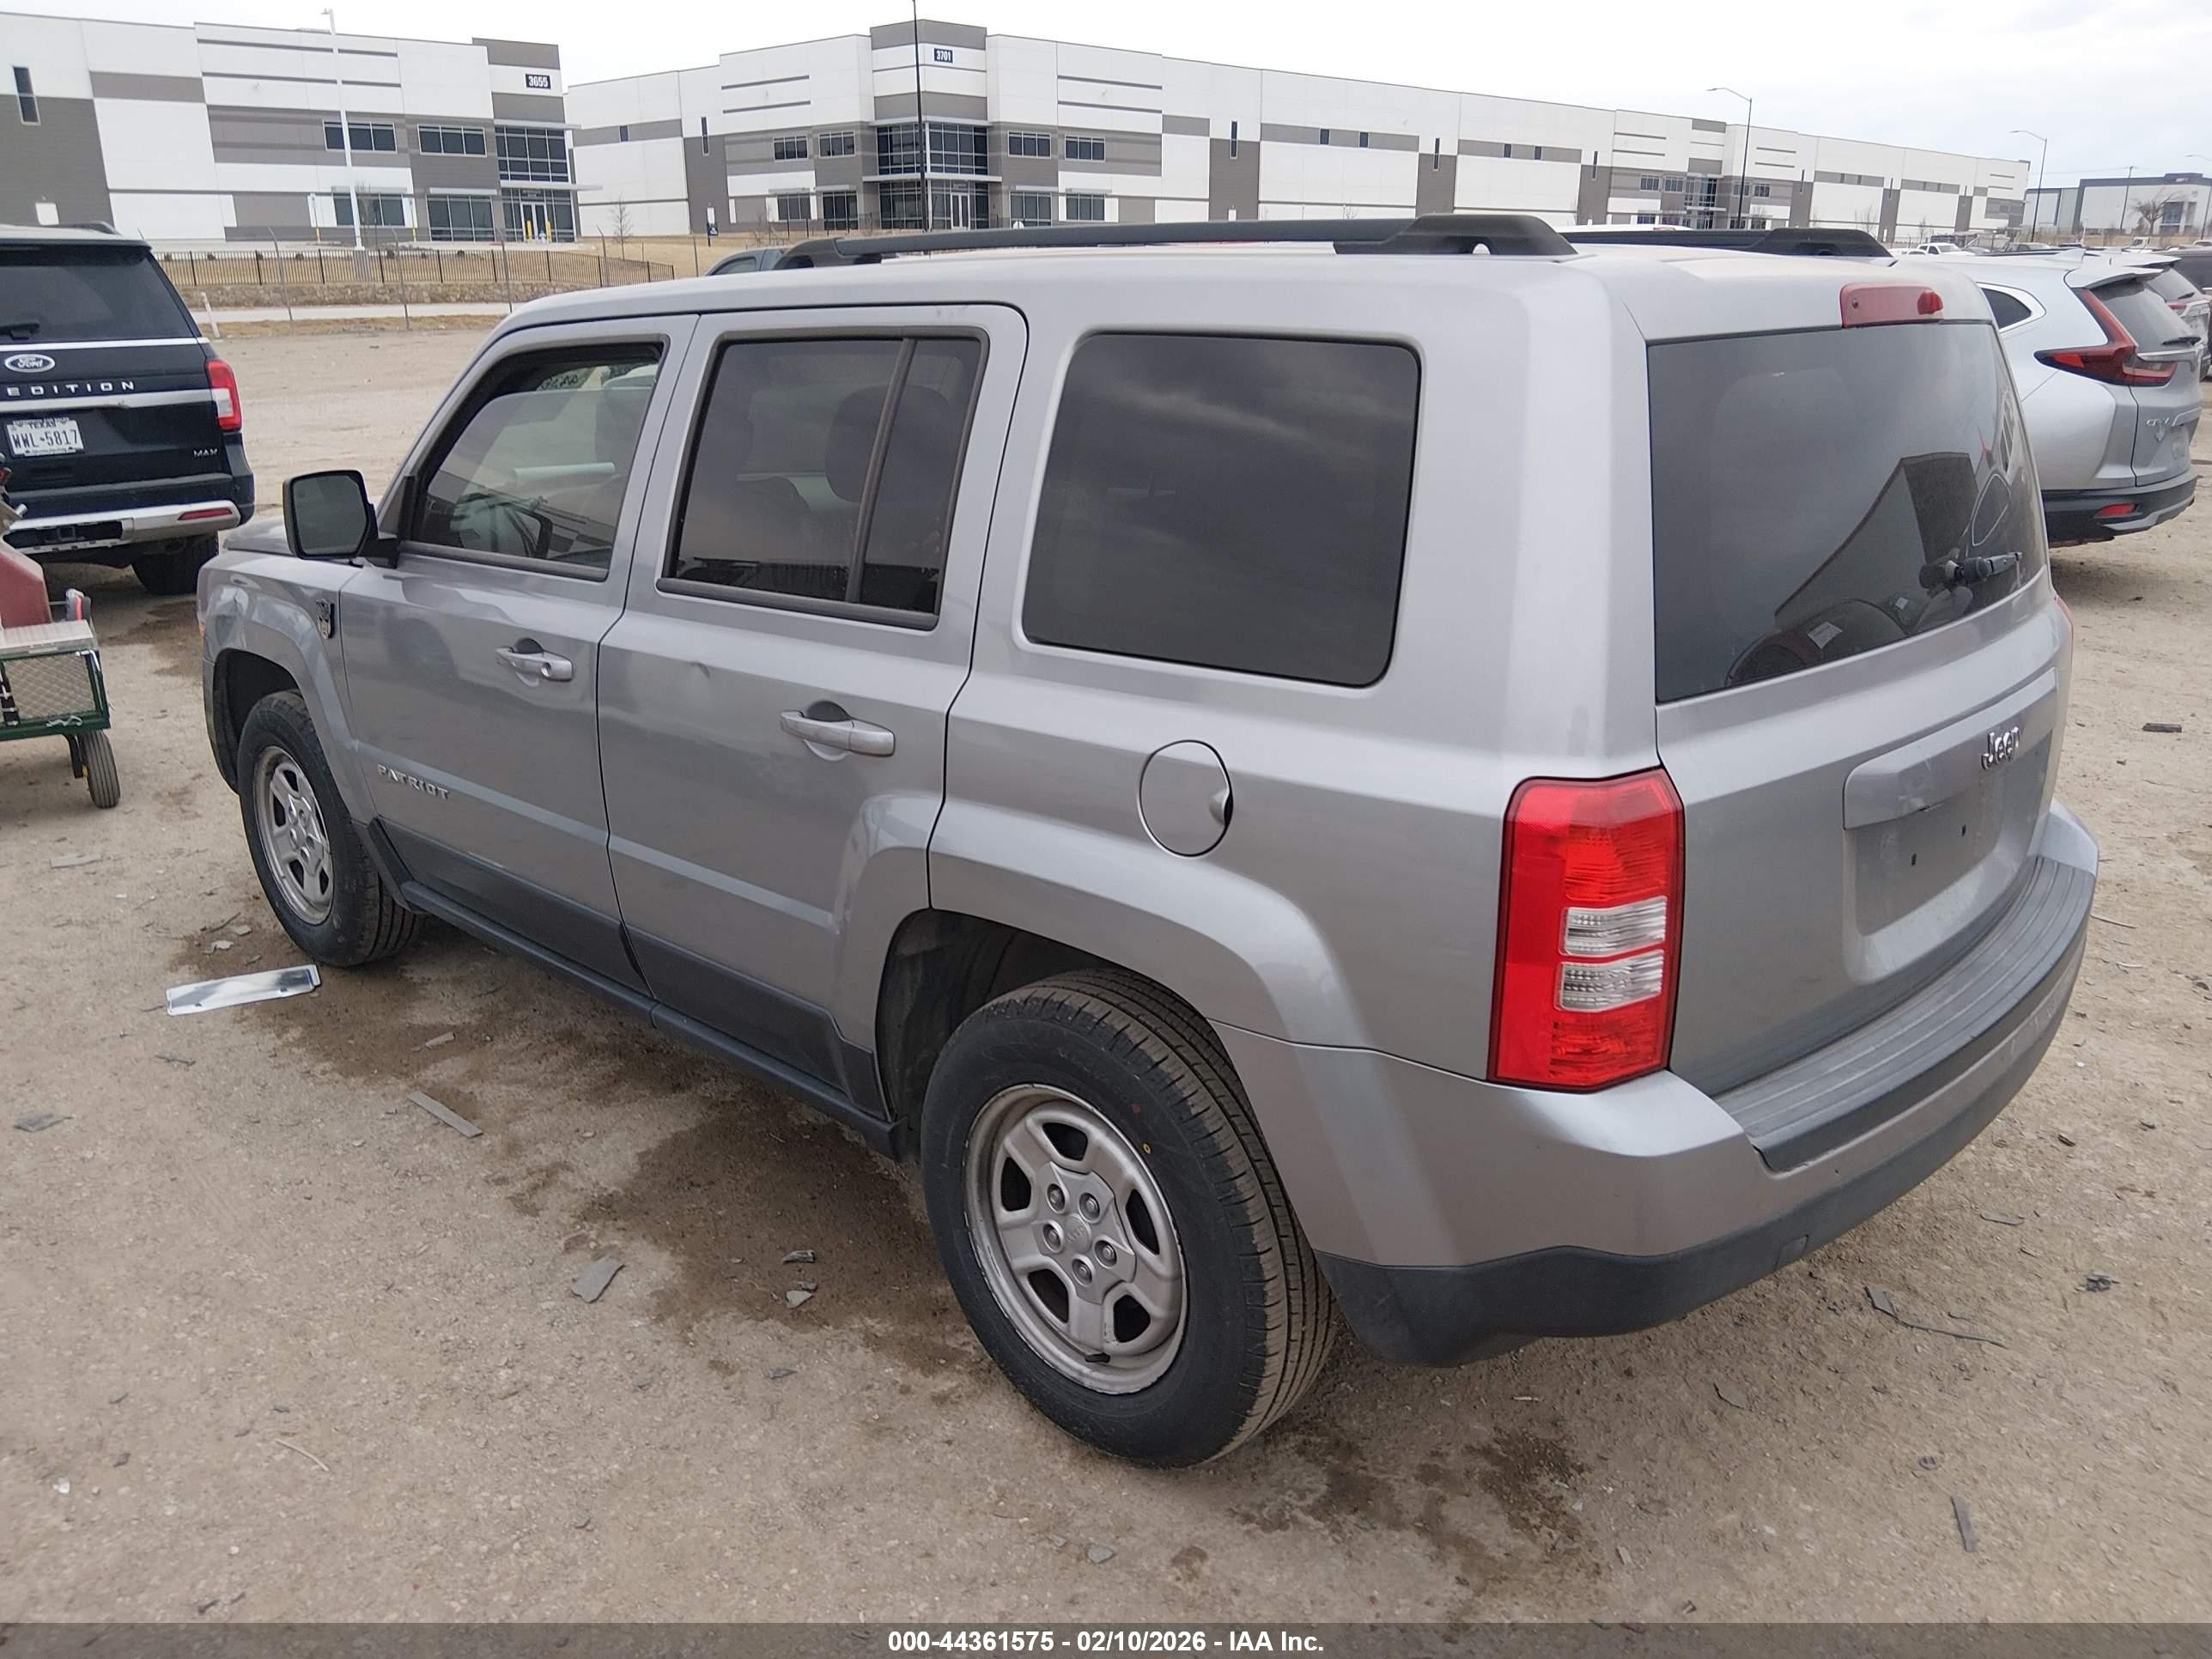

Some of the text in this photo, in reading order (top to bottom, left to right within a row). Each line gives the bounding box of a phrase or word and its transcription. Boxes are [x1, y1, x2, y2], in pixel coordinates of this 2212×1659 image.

[936, 50, 951, 61] 3701
[17, 356, 43, 368] Ford
[7, 380, 135, 396] EDITION
[1981, 726, 2020, 770] Jeep
[378, 763, 449, 800] PATRIOT
